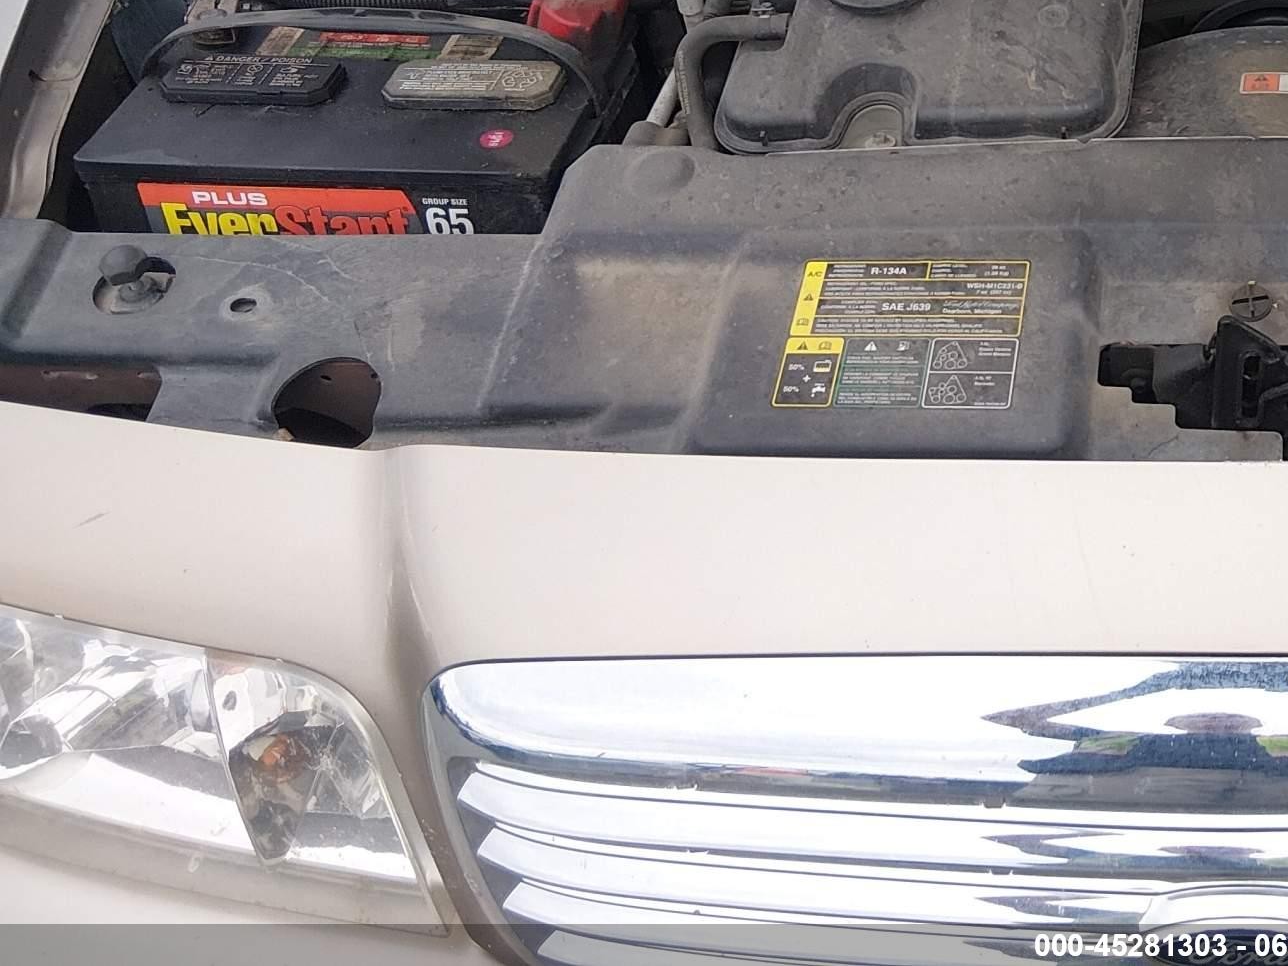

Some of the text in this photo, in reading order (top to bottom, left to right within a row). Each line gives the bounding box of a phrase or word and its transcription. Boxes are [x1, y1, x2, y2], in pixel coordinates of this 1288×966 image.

[216, 55, 260, 63] DANGER
[191, 191, 268, 206] PLUS
[422, 197, 449, 205] GROUP
[425, 207, 475, 235] 65
[870, 267, 907, 275] R-134A
[881, 302, 904, 311] SAE
[906, 302, 931, 311] J639
[783, 385, 800, 393] 50%
